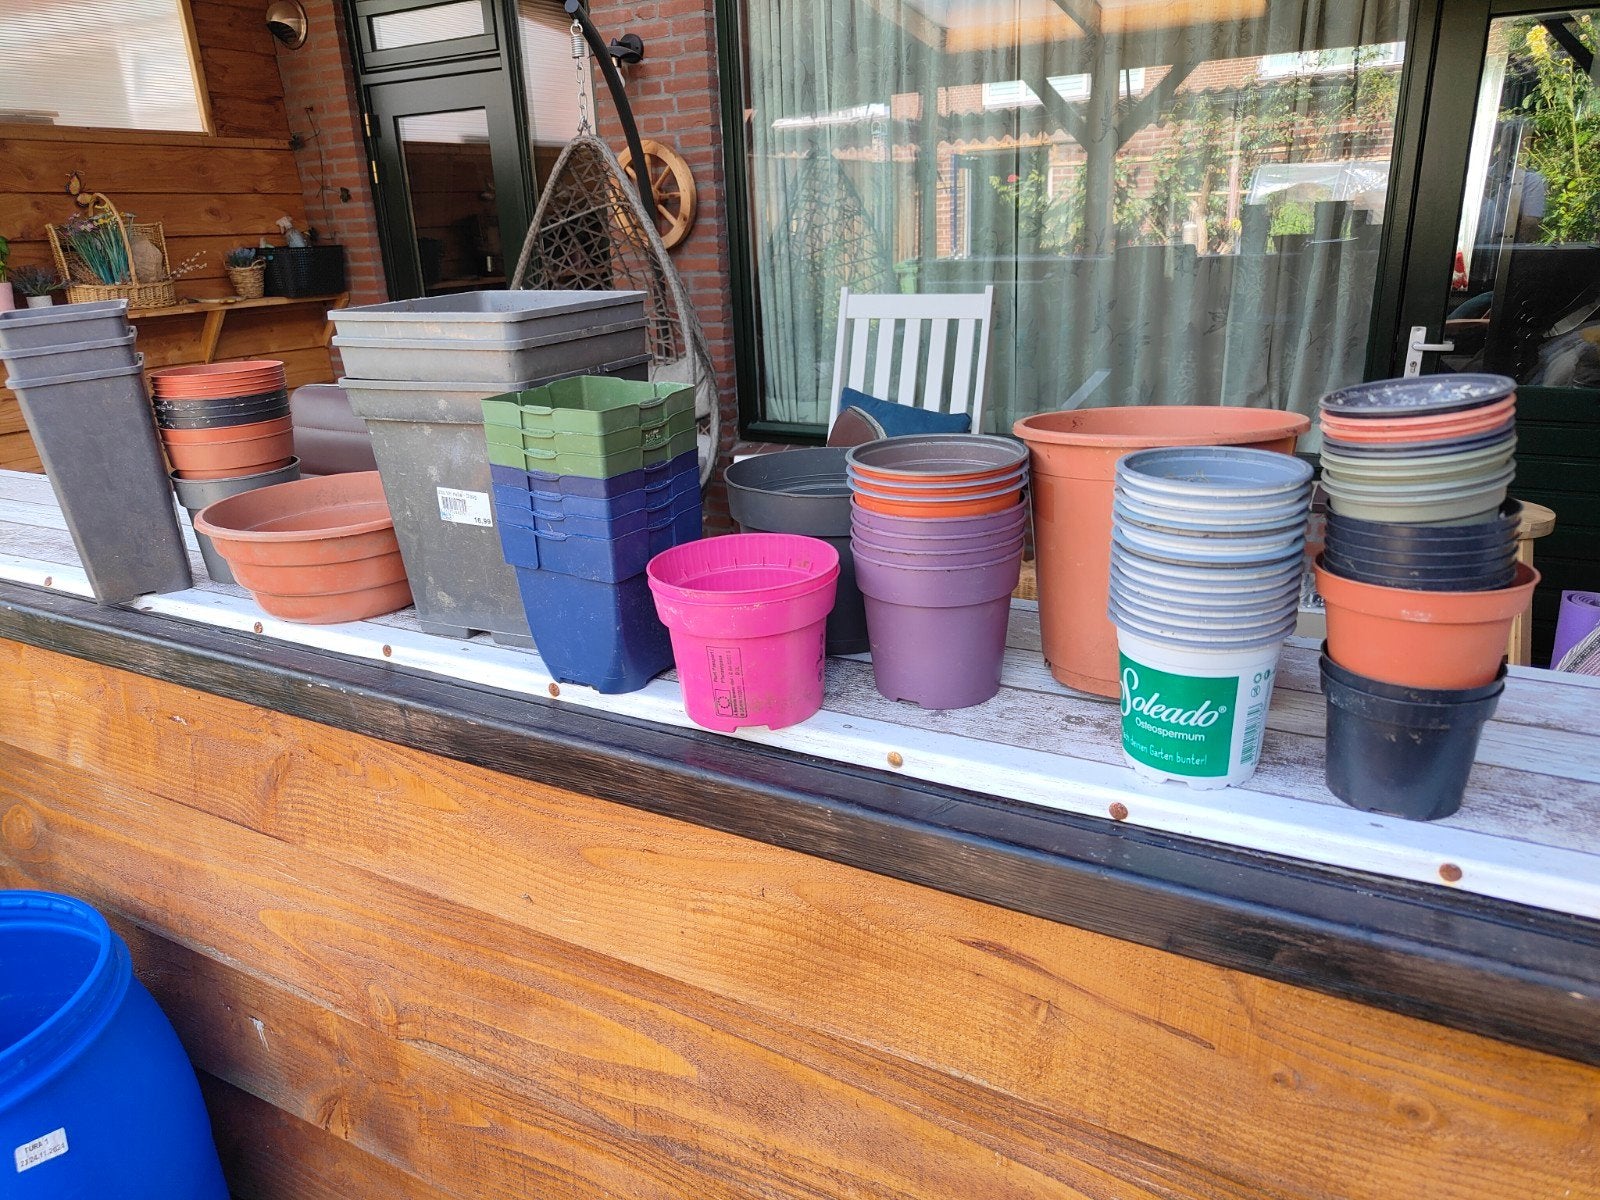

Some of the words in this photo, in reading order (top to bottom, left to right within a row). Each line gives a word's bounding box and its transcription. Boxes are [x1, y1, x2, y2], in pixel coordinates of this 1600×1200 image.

[474, 517, 491, 525] 16,99
[1135, 716, 1206, 742] Osteospermum
[1149, 744, 1174, 761] Garten
[1176, 752, 1207, 765] bunter!
[24, 1141, 43, 1153] TURA
